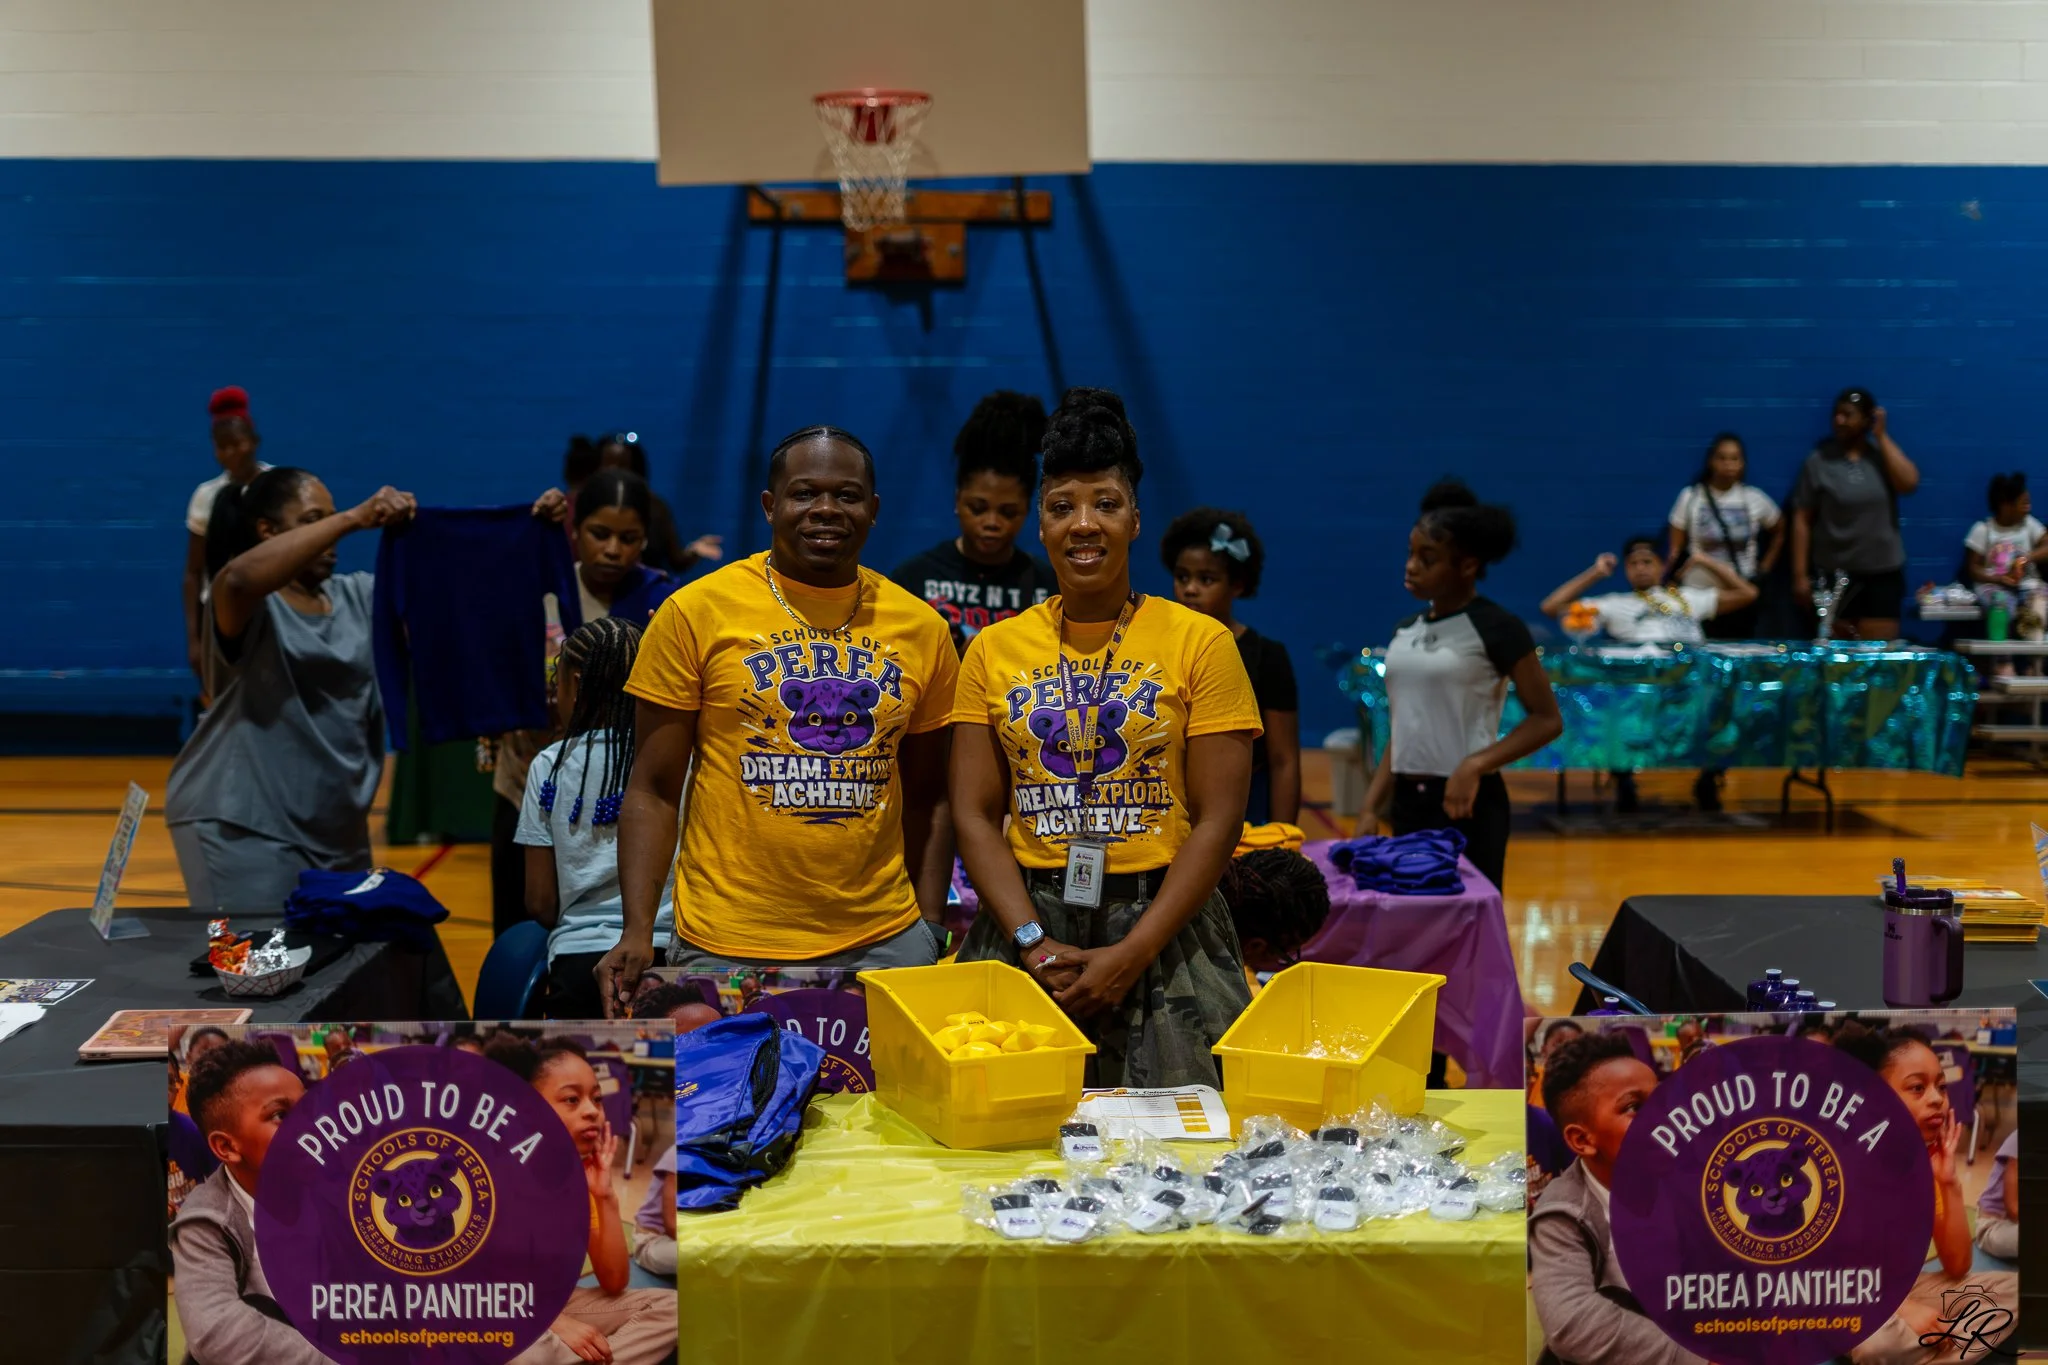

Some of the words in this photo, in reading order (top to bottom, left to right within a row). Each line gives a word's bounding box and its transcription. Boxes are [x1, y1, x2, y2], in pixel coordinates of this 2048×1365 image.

[924, 579, 981, 604] BOYZ
[986, 585, 1003, 608] N
[770, 628, 852, 645] SCHOOLS
[861, 636, 882, 652] OF
[742, 642, 903, 701] PEREA
[1121, 659, 1144, 674] OF
[1006, 672, 1165, 724] PEREA
[1066, 692, 1073, 702] GO
[816, 1016, 846, 1046] TO
[853, 1026, 871, 1060] B
[841, 1068, 864, 1093] PER
[297, 1084, 404, 1166] PROUD
[421, 1081, 460, 1119] TO
[470, 1093, 518, 1142] BE
[510, 1132, 544, 1165] A
[1650, 1073, 1757, 1158] PROUD
[1771, 1072, 1810, 1110] TO
[1818, 1081, 1865, 1131] BE
[1857, 1118, 1890, 1153] A
[354, 1133, 418, 1202] SCHOOLS
[426, 1134, 451, 1149] OF
[454, 1146, 490, 1202] PEREA
[1707, 1123, 1769, 1193] SCHOOLS
[1777, 1123, 1801, 1138] OF
[1804, 1135, 1839, 1191] PEREA
[363, 1216, 423, 1265] PREPARING
[429, 1214, 482, 1264] STUDENTS
[1715, 1205, 1774, 1253] PREPARING
[1780, 1202, 1831, 1251] STUDENTS
[438, 1258, 454, 1269] AND
[311, 1283, 398, 1321] PEREA
[405, 1282, 534, 1320] PANTHER!
[1666, 1271, 1750, 1311] PEREA
[1756, 1268, 1882, 1310] PANTHER!
[339, 1329, 514, 1348] schoolsofperea.org
[1694, 1315, 1863, 1336] schoolsofperea.org
